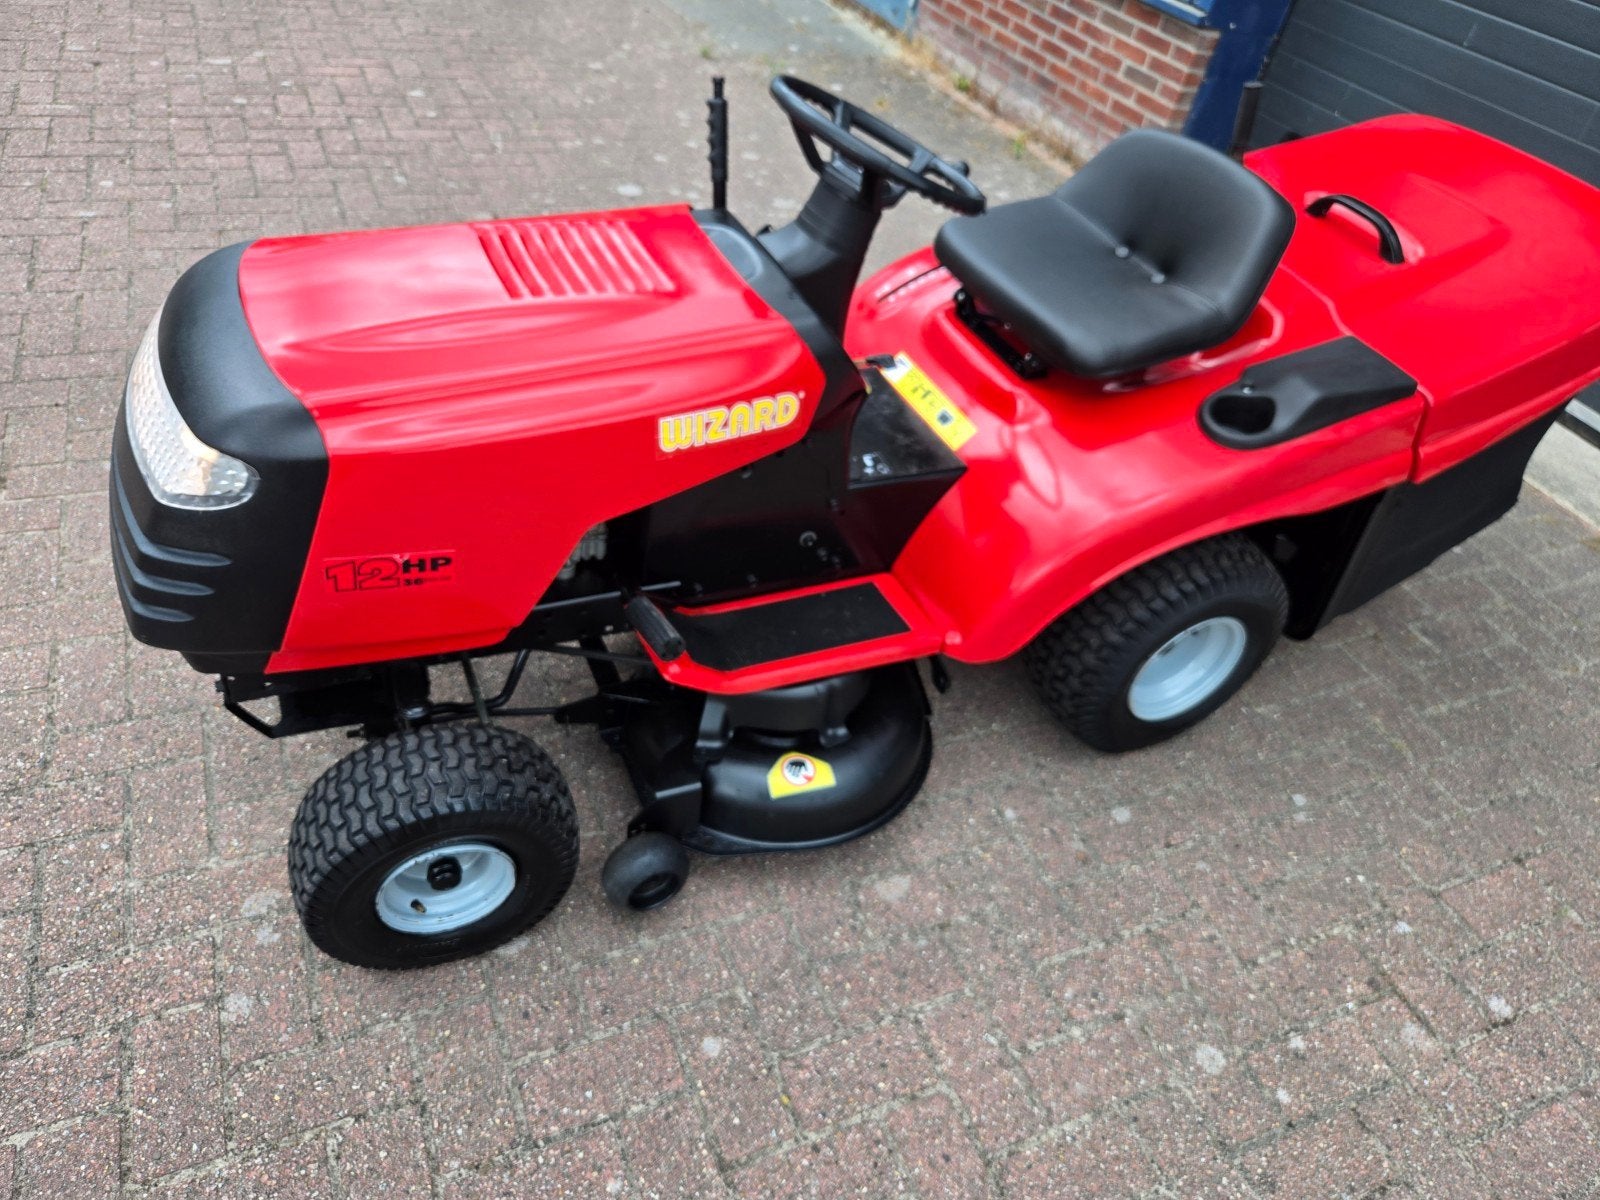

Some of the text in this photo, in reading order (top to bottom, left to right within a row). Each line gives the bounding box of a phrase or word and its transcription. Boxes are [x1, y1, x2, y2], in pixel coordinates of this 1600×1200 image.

[659, 391, 800, 452] WIZARD
[325, 557, 452, 592] 12 HP
